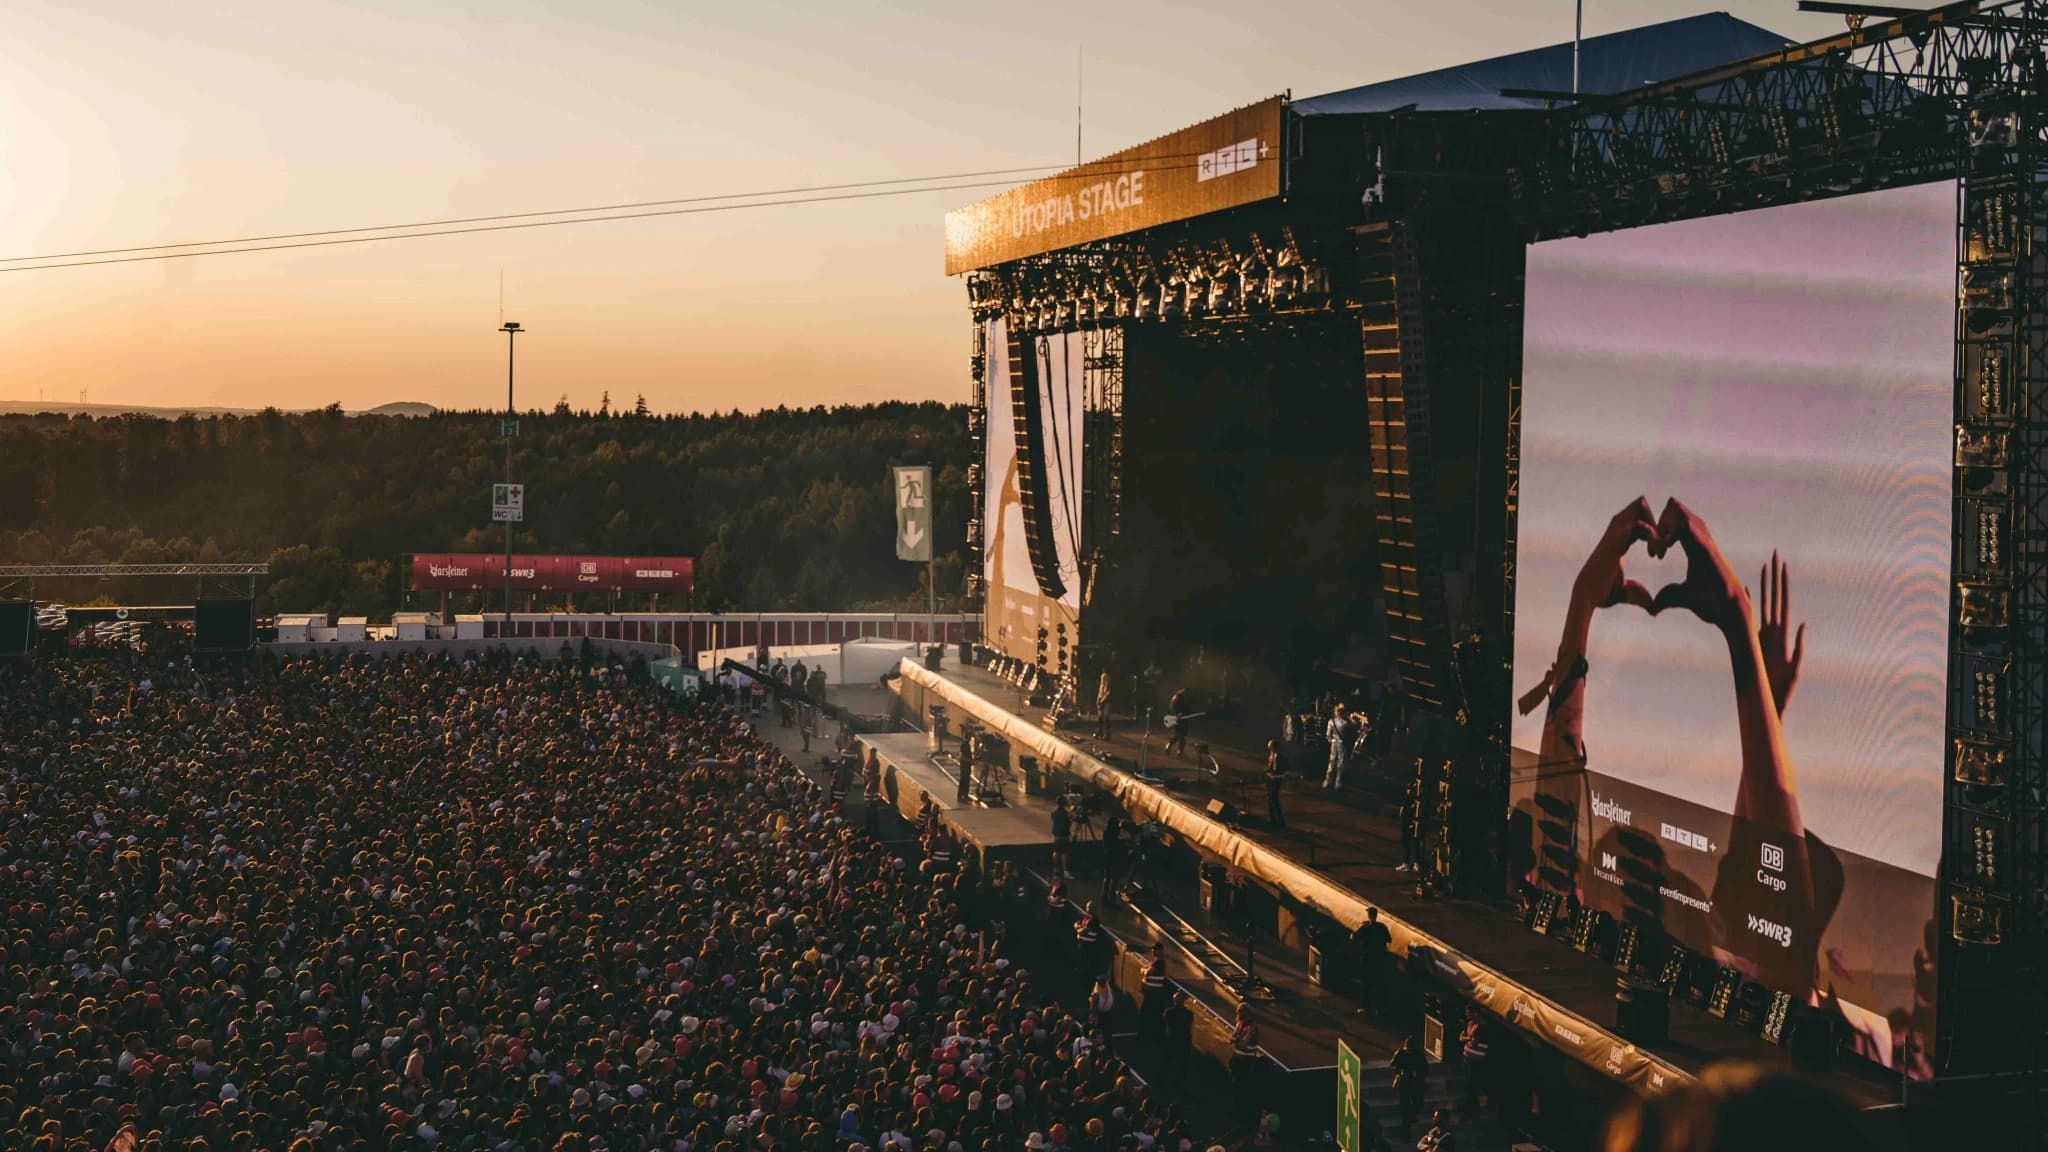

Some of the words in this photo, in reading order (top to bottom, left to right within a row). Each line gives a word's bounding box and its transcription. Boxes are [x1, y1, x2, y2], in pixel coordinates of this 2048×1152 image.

[1198, 138, 1269, 181] RTL+
[1012, 193, 1075, 238] UTOPIA
[1079, 170, 1144, 220] STAGE
[494, 510, 508, 518] WC
[578, 574, 599, 583] Cargo
[1661, 823, 1717, 852] RTL+
[1763, 846, 1782, 868] DB
[1757, 869, 1787, 892] Cargo
